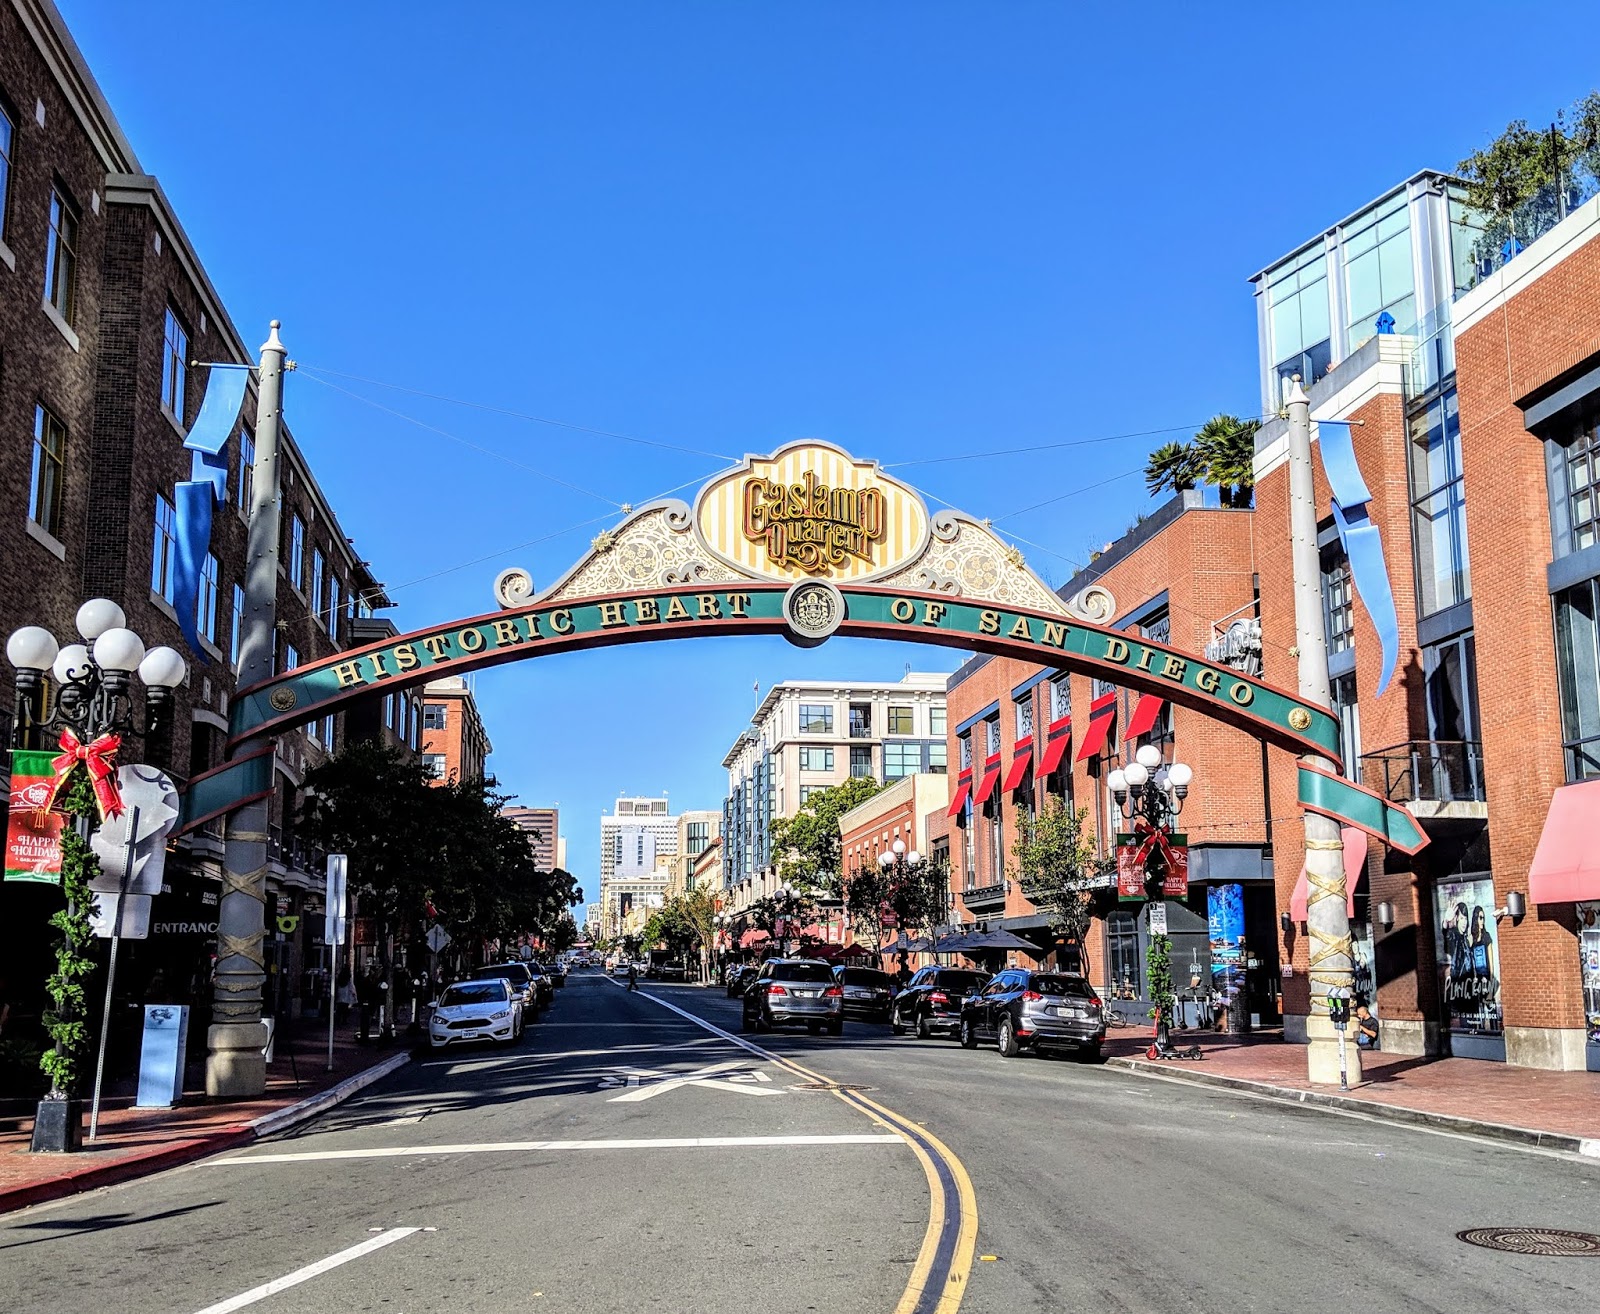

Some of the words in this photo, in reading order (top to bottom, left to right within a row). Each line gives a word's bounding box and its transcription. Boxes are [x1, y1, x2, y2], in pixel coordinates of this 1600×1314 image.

[742, 470, 882, 541] Gaslamp
[766, 519, 871, 572] Quarter
[332, 609, 573, 688] HISTORIC
[598, 593, 749, 626] HEART
[890, 598, 944, 624] OF
[979, 609, 1068, 646] SAN
[1102, 637, 1254, 705] DIEGO
[10, 845, 60, 860] HOLIDAYS
[18, 836, 57, 847] HAPPY
[153, 922, 218, 933] ENTRANC
